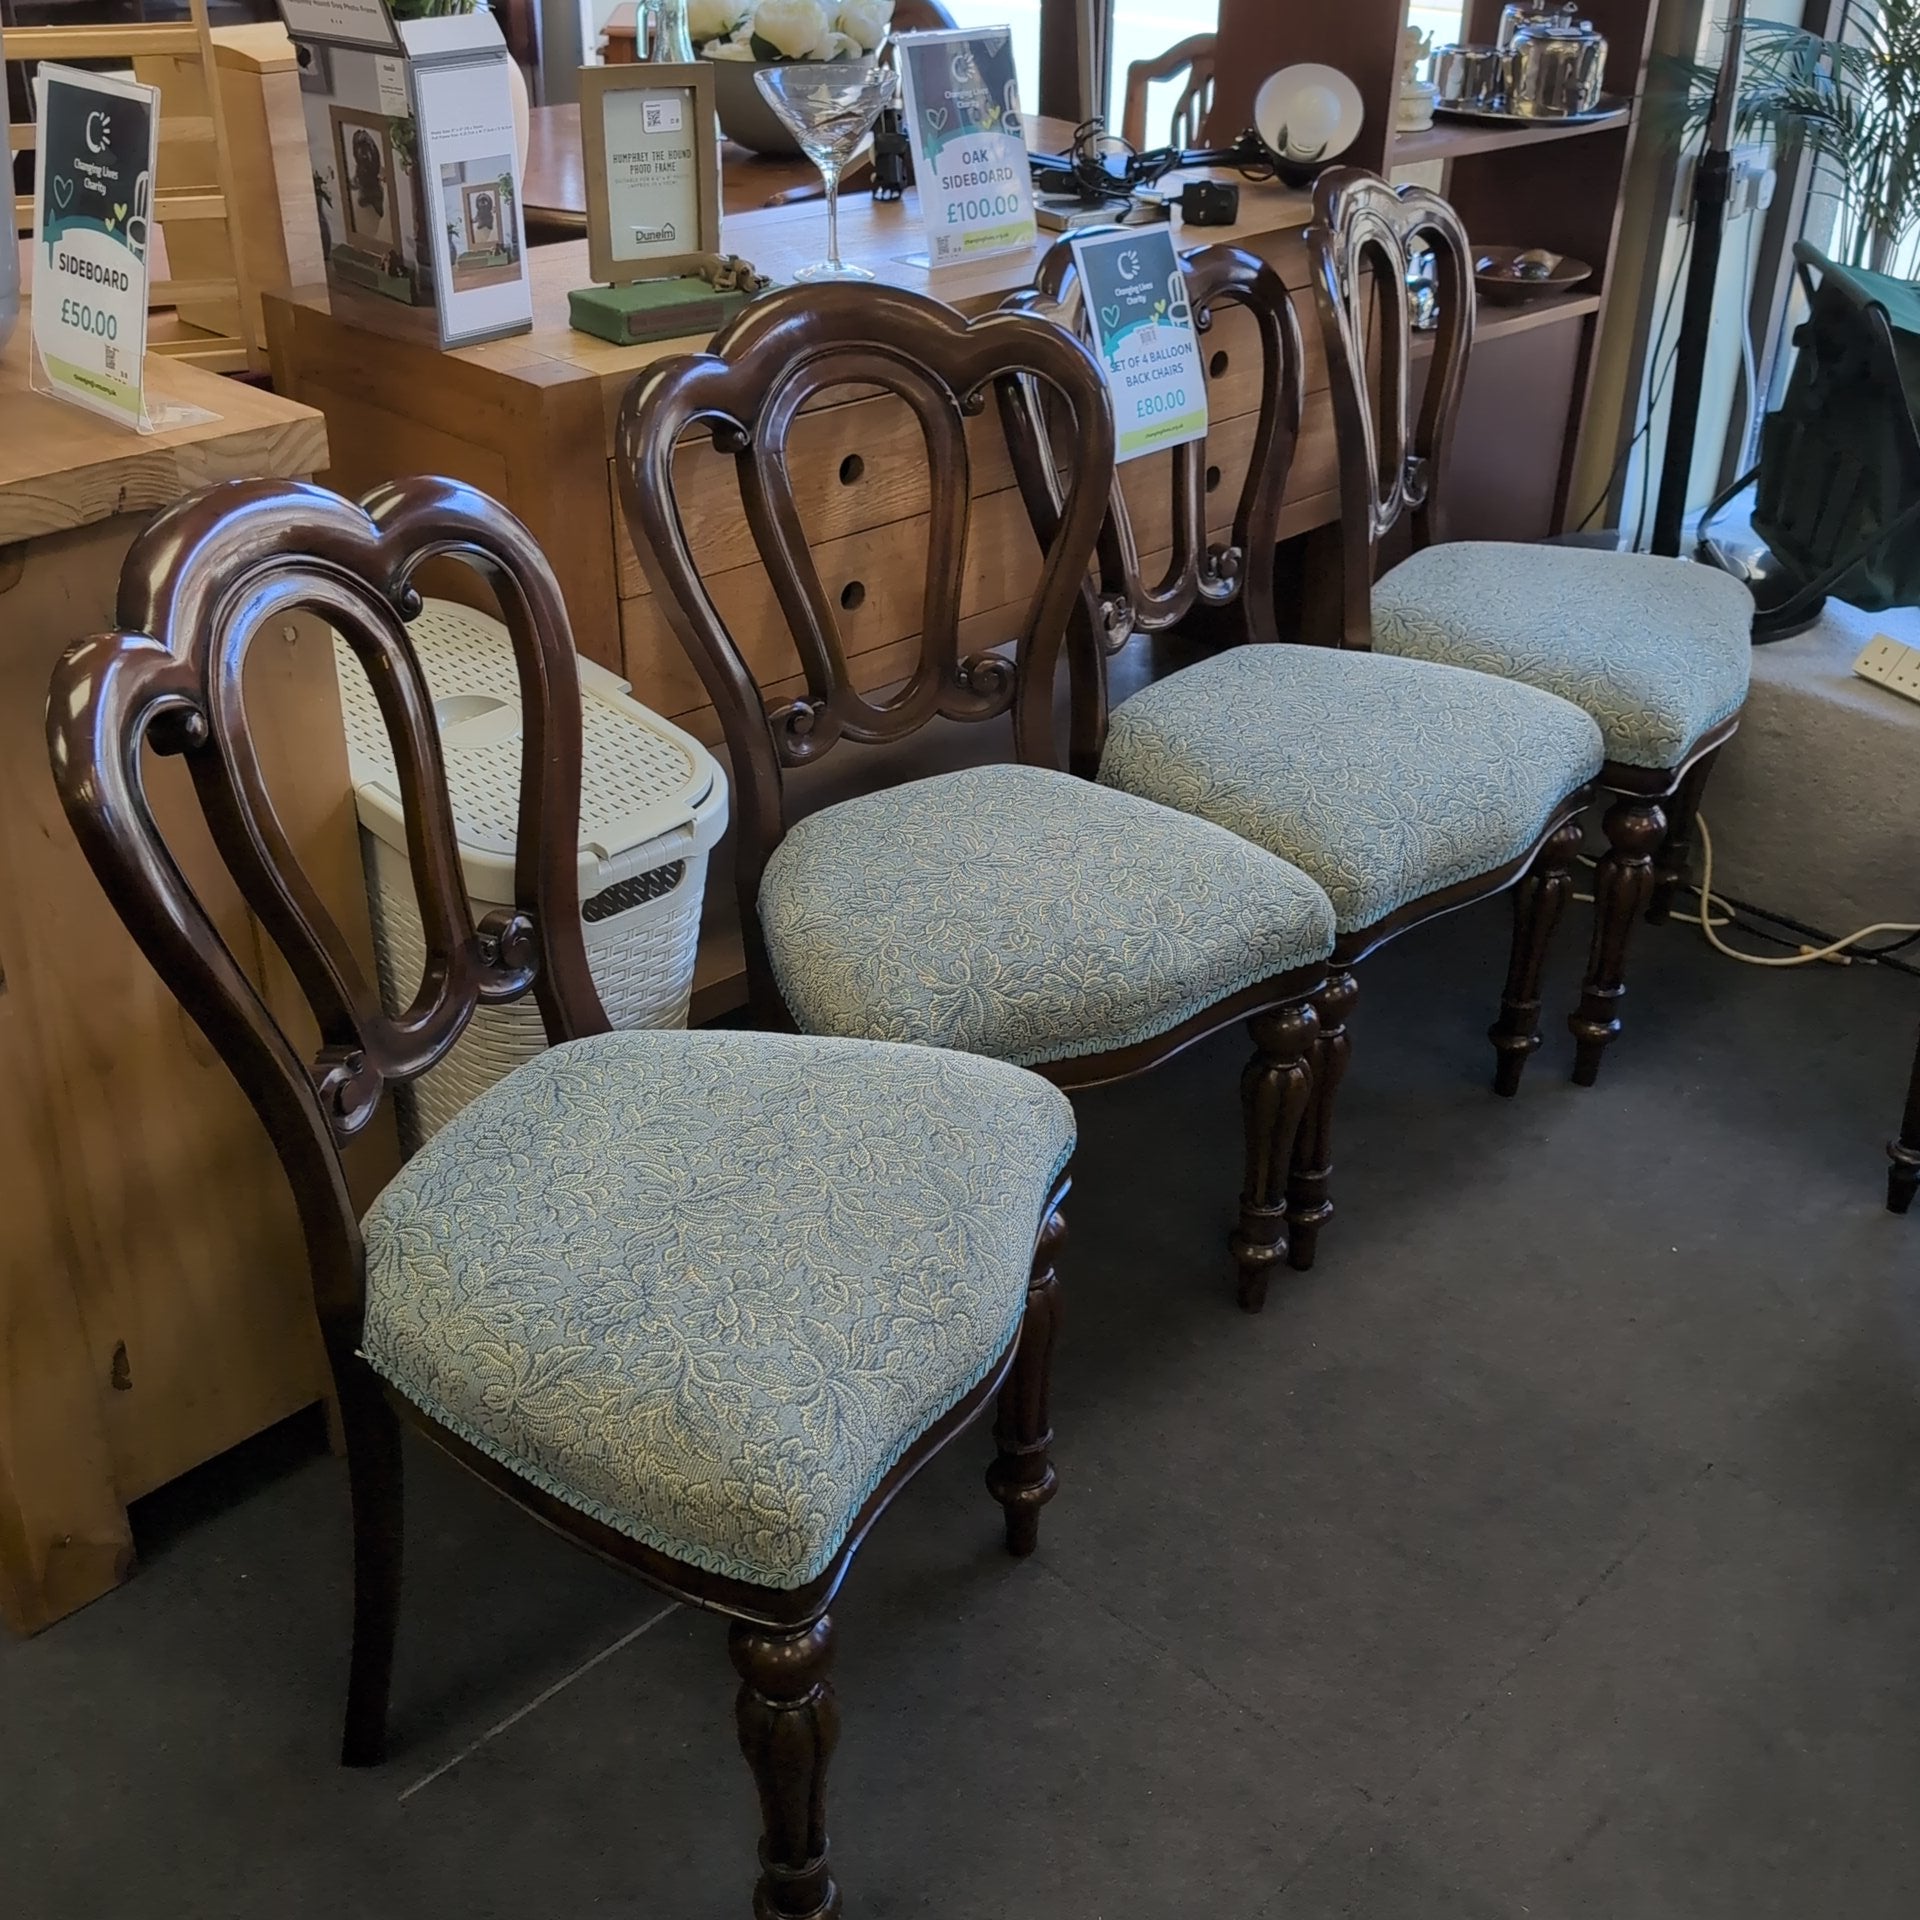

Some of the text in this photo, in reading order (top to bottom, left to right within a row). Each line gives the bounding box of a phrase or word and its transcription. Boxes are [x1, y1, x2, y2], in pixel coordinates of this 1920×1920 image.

[612, 148, 692, 164] HUMPHREY THE HOUND
[629, 161, 677, 175] PHOTO FRAME
[962, 149, 990, 165] OAK
[942, 167, 1013, 190] SIDEBOARD
[946, 193, 1019, 224] £100.00
[635, 228, 674, 242] Dunelm
[58, 252, 129, 292] SIDEBOARD
[61, 298, 117, 341] £50.00
[1110, 342, 1193, 374] SET OF 4 BALLOON
[1125, 362, 1185, 388] BACK CHAIRS
[1136, 388, 1186, 418] £80.00
